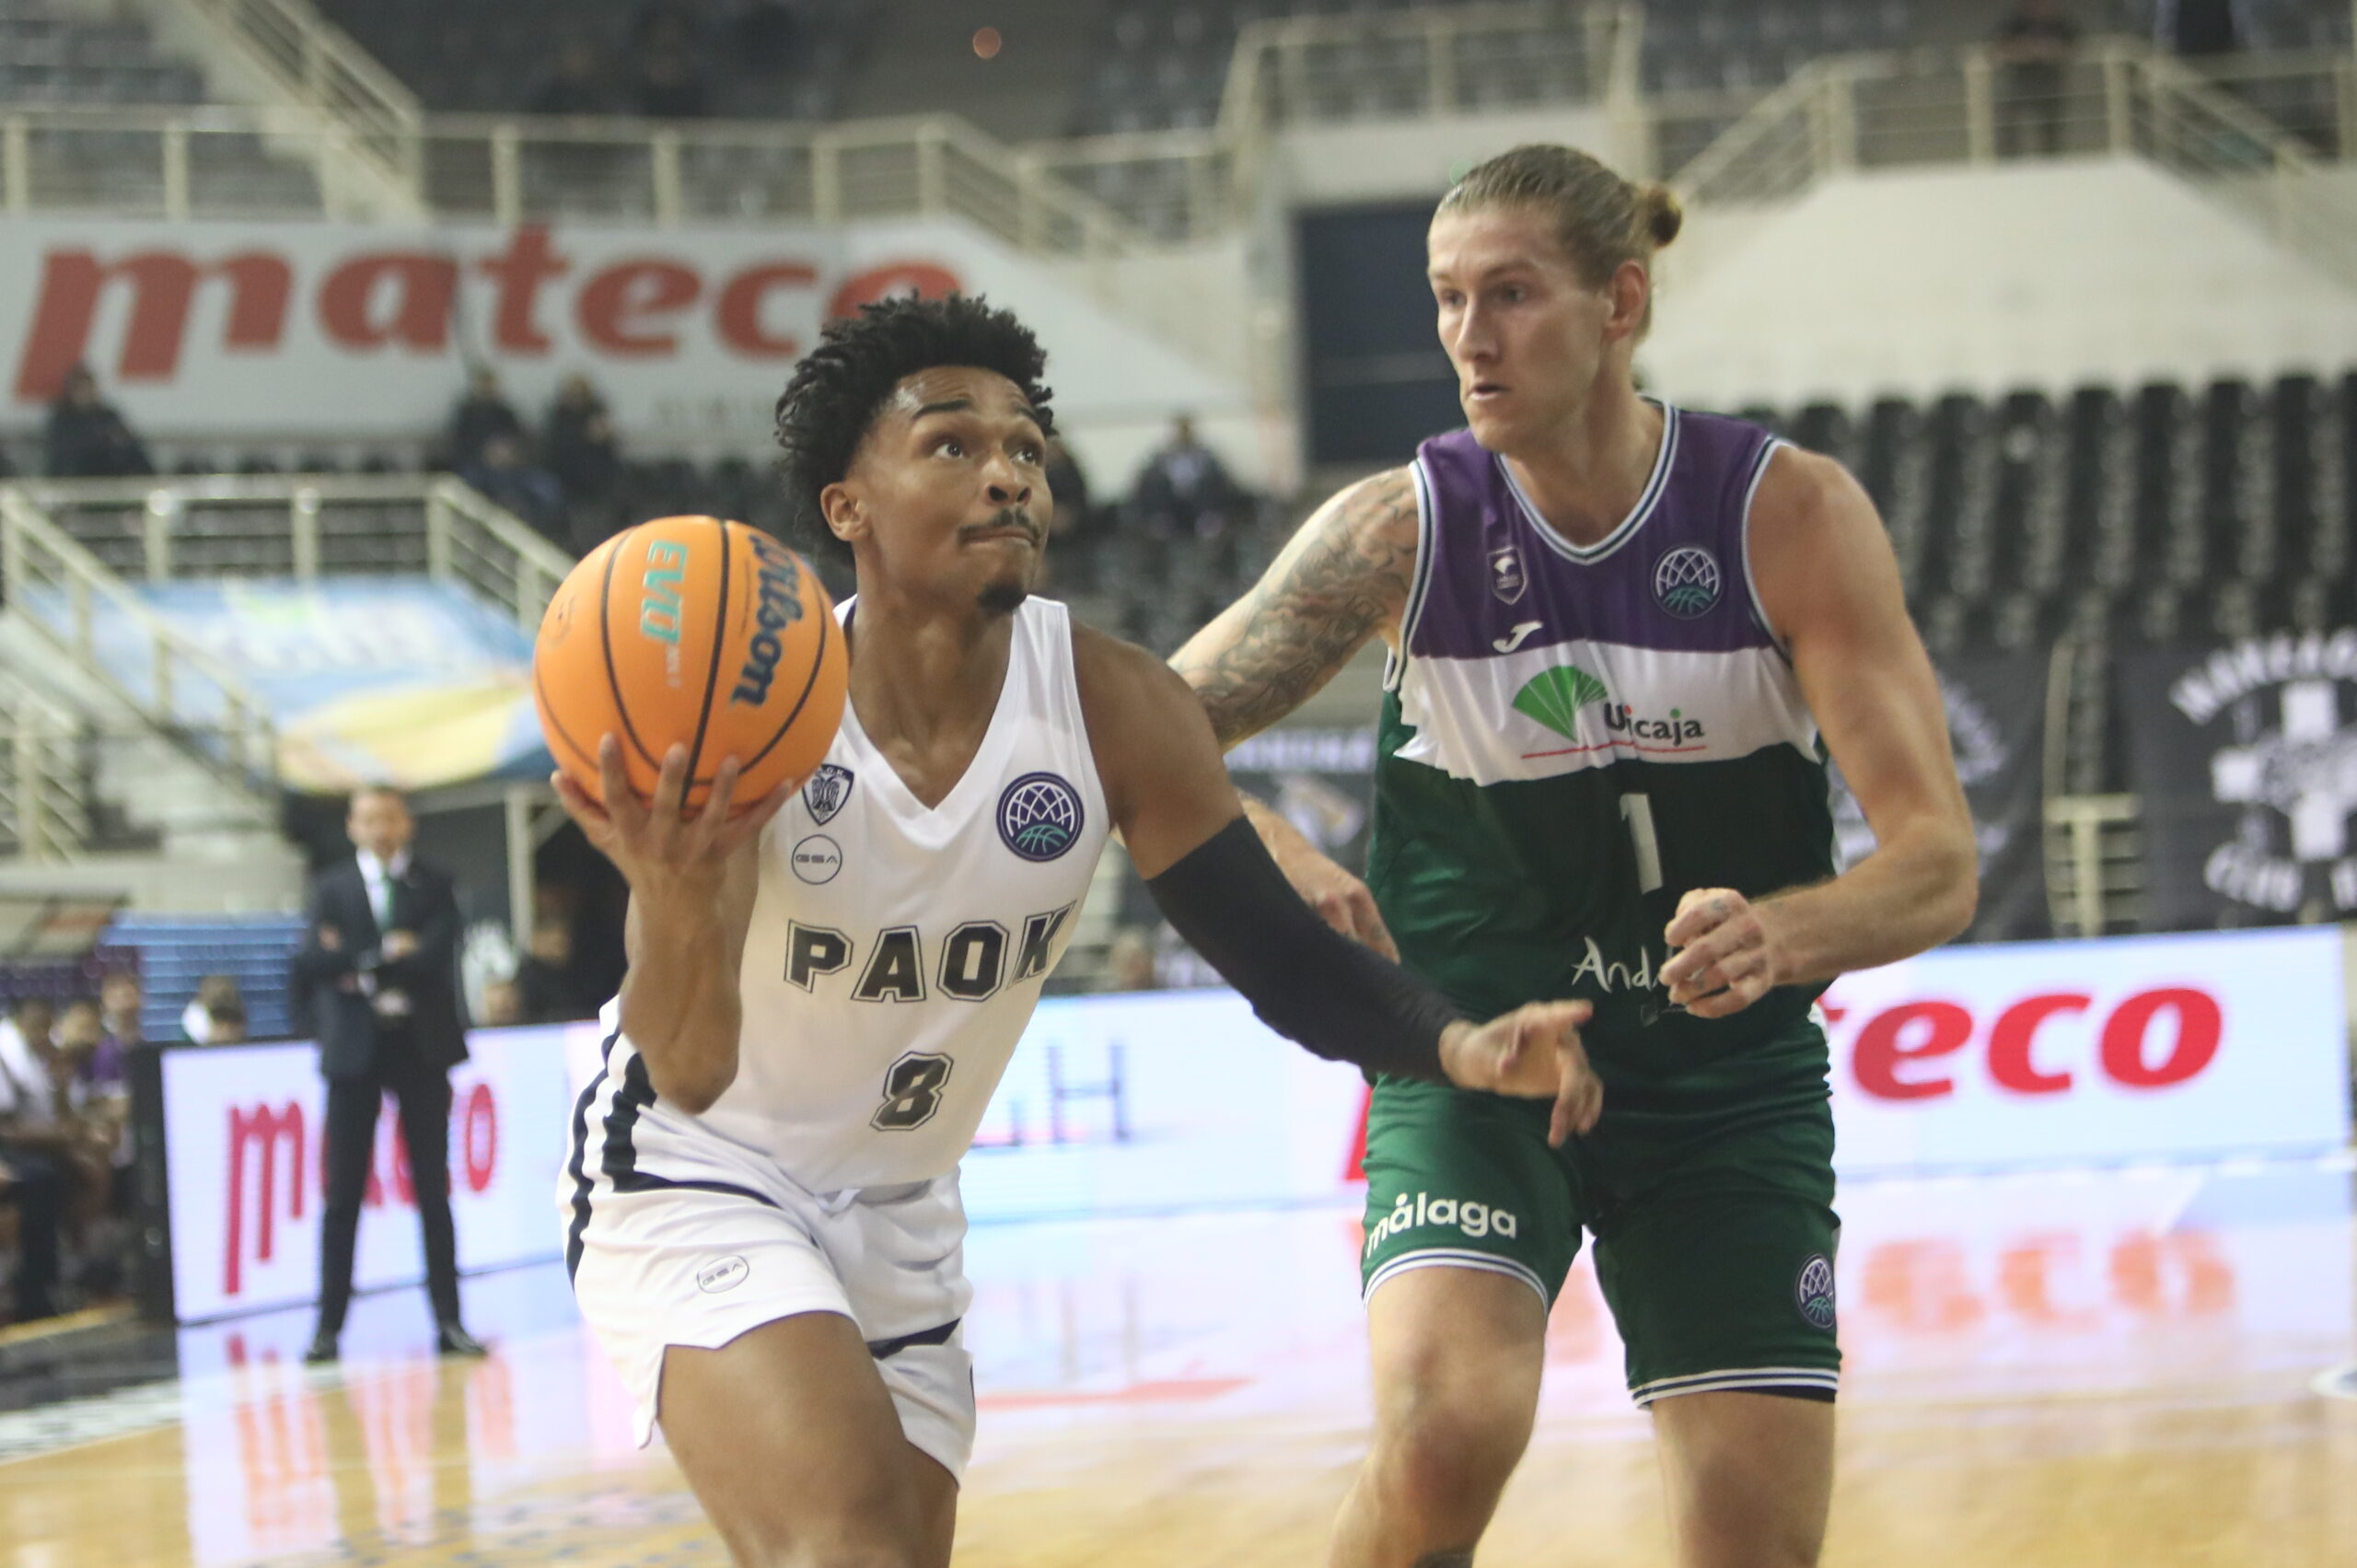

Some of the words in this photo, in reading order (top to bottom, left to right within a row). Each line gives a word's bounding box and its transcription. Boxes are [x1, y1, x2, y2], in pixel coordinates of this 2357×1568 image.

[641, 540, 688, 644] EVO
[1604, 703, 1705, 748] Uicaja
[1618, 792, 1664, 895] 1
[784, 899, 1078, 1004] PAOK
[868, 1050, 954, 1132] 8
[1819, 988, 2223, 1101] eco
